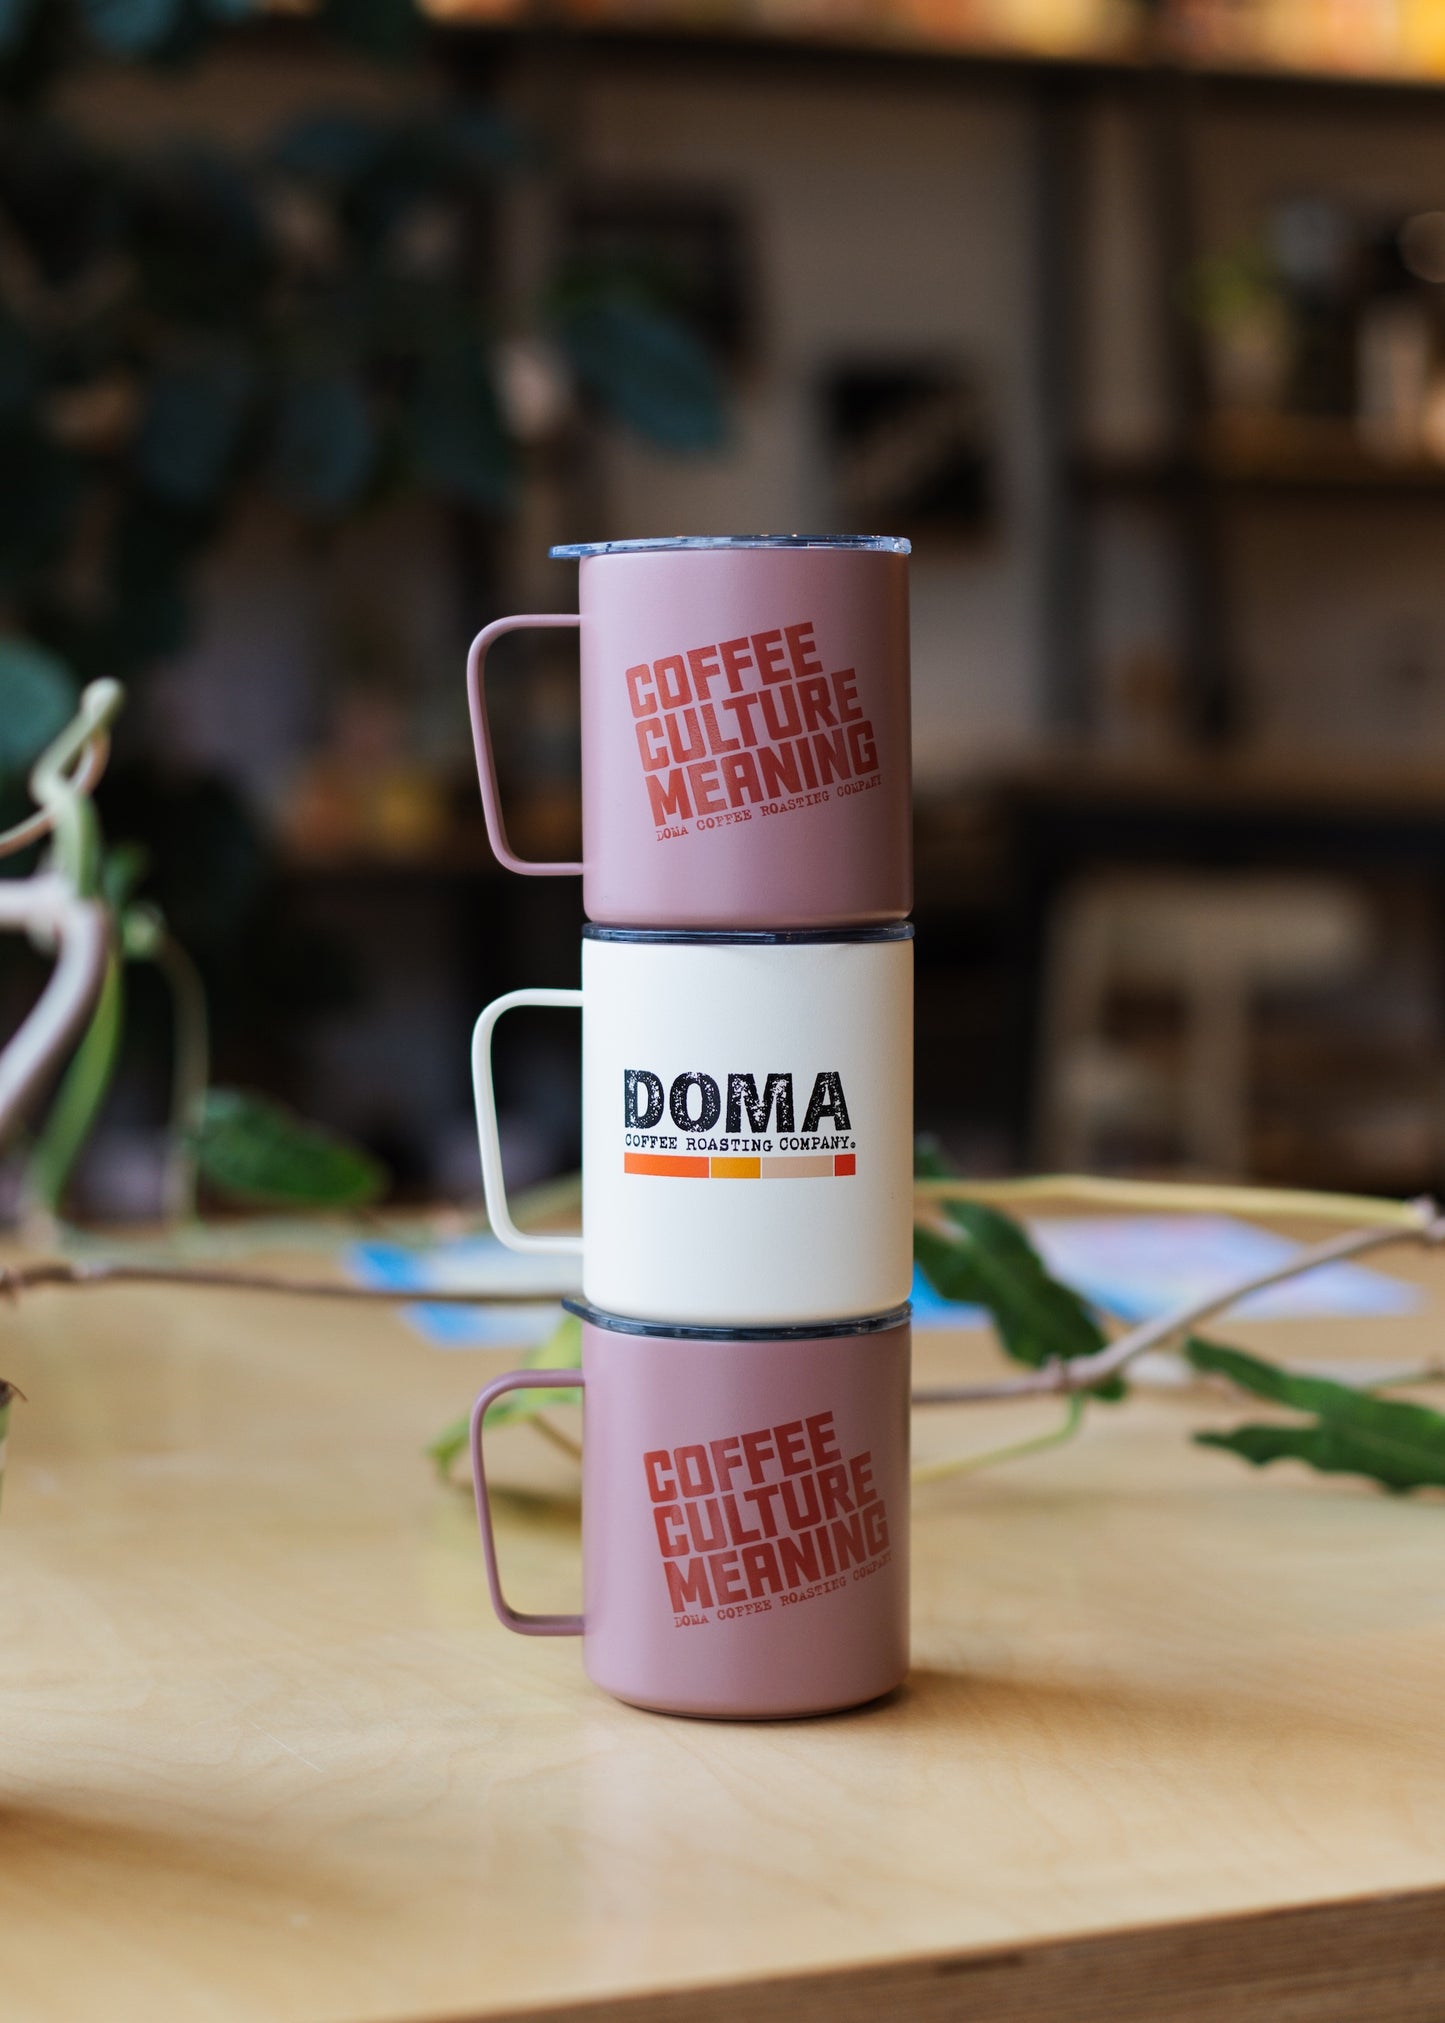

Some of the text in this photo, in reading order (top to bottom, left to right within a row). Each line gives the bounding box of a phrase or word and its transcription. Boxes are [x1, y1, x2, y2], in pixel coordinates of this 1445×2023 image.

[625, 621, 823, 718] COFFEE
[635, 668, 864, 772] CULTURE
[645, 720, 879, 827] MEANING
[656, 774, 883, 842] DOMA COFFEE ROASTING COMPANY
[624, 1069, 852, 1133] DOMA
[625, 1134, 678, 1150] COFFEE
[686, 1137, 773, 1152] ROASTING
[643, 1411, 842, 1503] COFFEE
[653, 1451, 878, 1558] CULTURE
[663, 1500, 890, 1613] MEANING
[674, 1614, 709, 1628] DOMA
[717, 1600, 772, 1621] COFFEE
[780, 1577, 847, 1606] ROASTING
